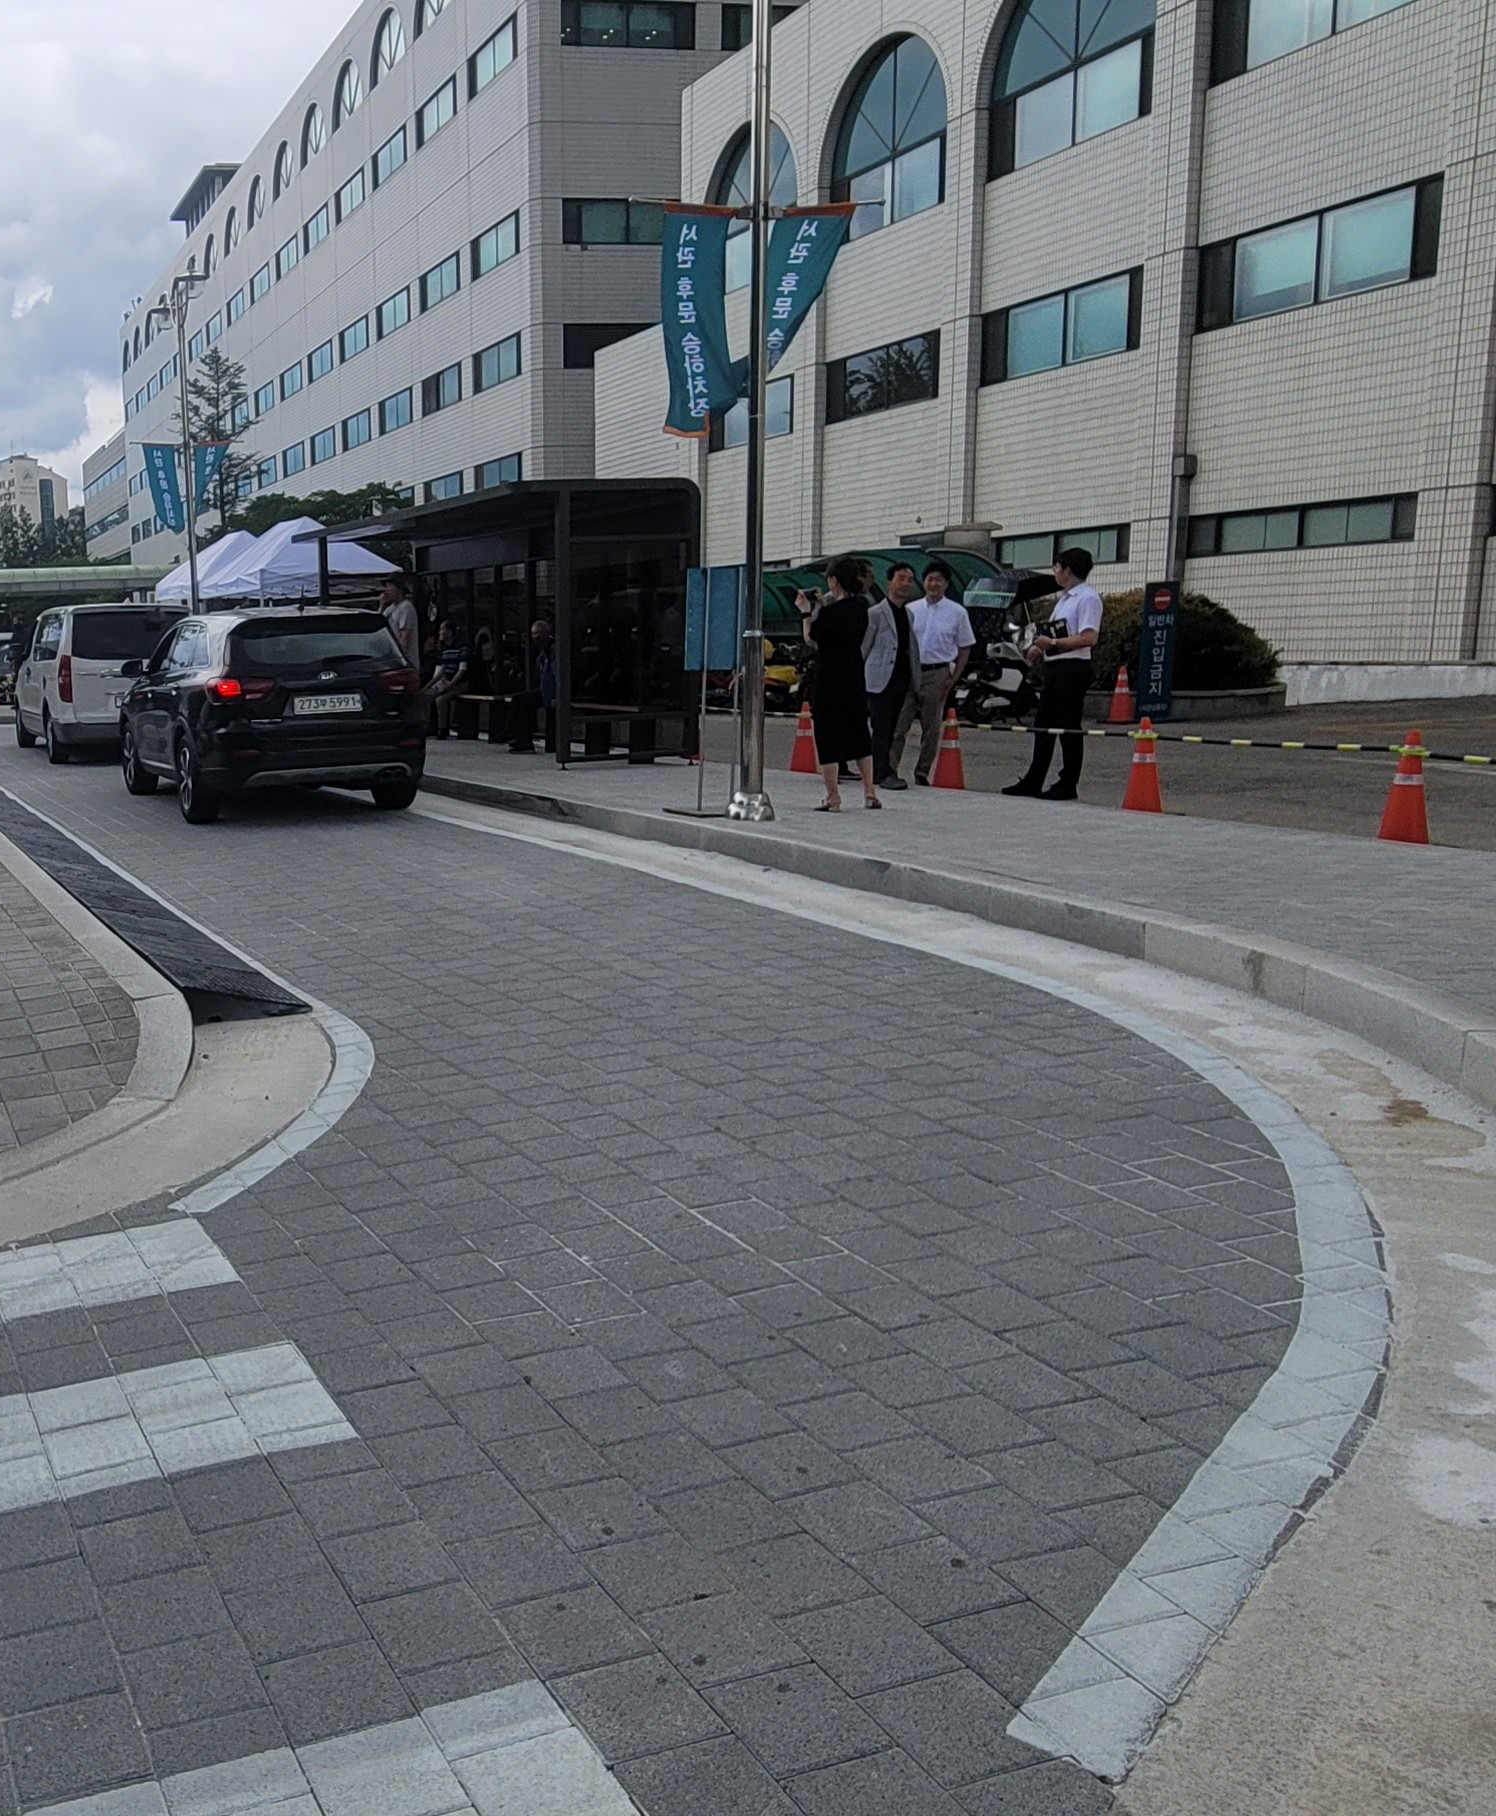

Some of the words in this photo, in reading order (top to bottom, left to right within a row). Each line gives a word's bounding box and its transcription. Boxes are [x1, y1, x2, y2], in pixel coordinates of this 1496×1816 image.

[1148, 614, 1175, 627] 일반차
[1148, 629, 1167, 696] 진입금지
[329, 696, 356, 708] 5991
